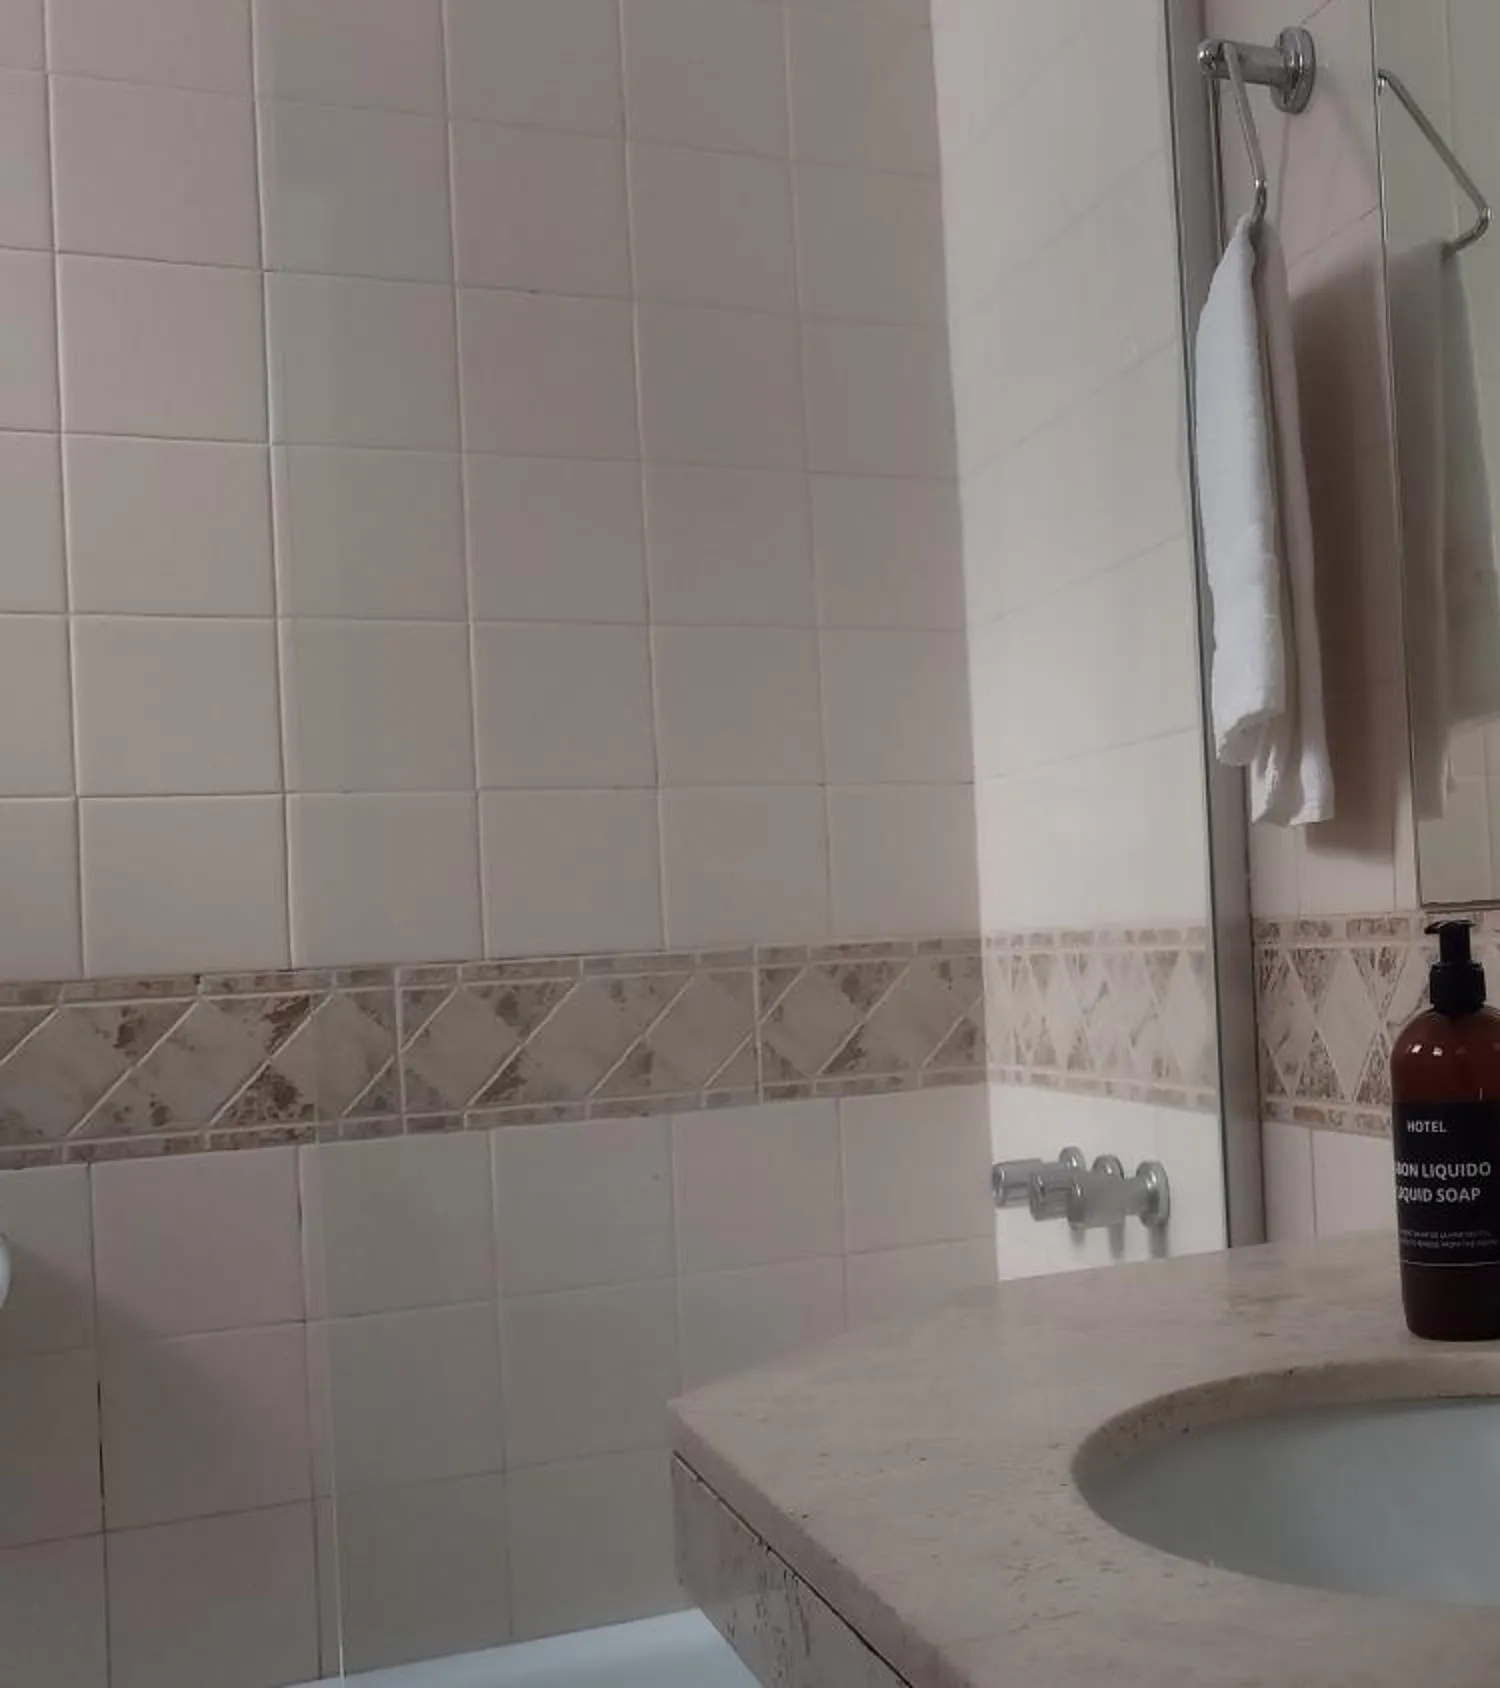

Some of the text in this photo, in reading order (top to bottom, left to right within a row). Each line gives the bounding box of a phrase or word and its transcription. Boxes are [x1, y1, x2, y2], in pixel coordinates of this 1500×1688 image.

[1407, 1120, 1447, 1133] HOTEL
[1421, 1161, 1492, 1180] LIQUIDO
[1436, 1187, 1481, 1203] SOAP
